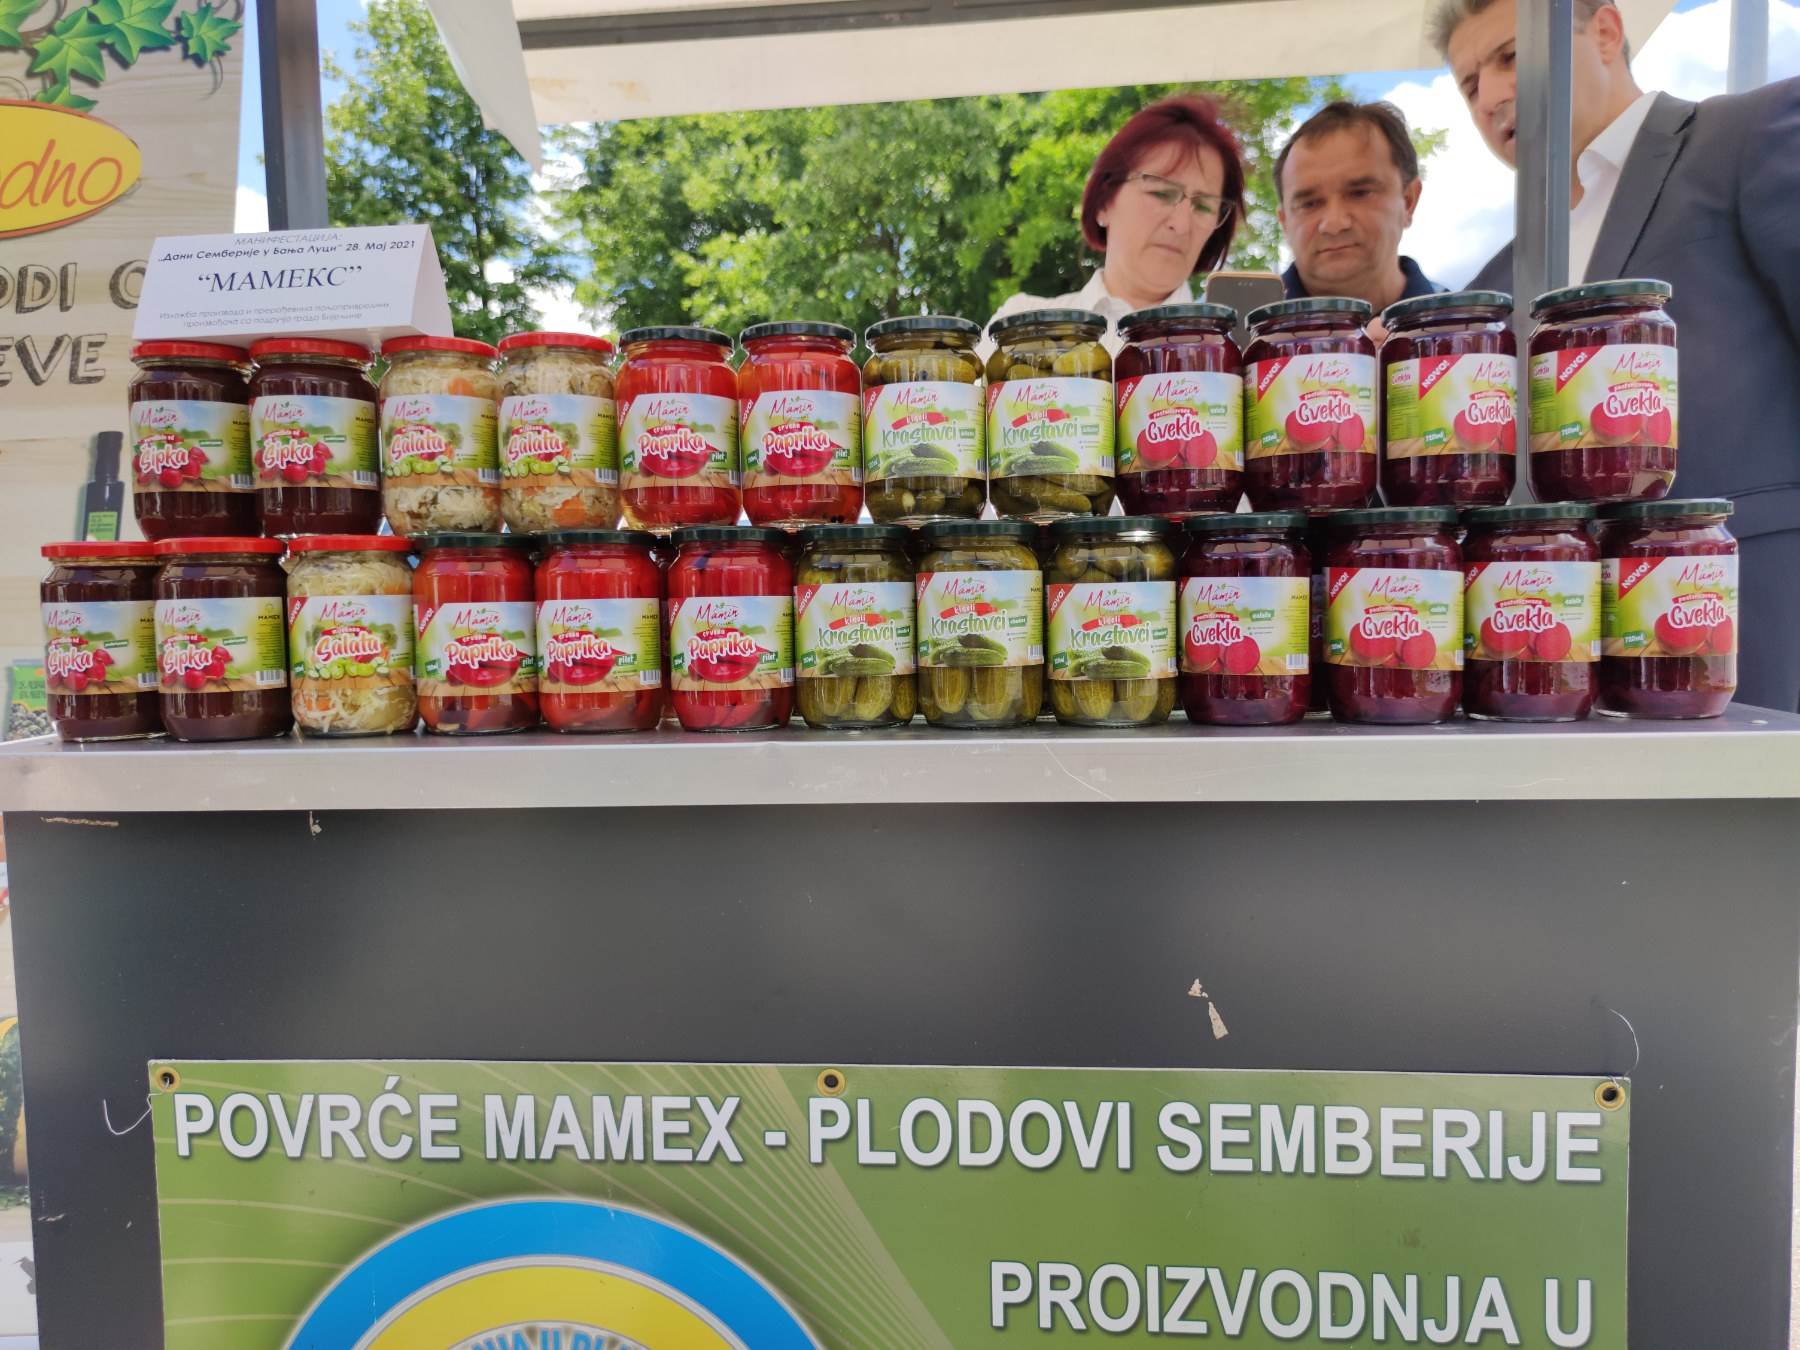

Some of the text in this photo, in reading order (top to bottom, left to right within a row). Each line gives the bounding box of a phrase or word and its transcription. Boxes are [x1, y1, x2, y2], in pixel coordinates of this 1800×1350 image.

[196, 248, 260, 260] Семберије
[273, 246, 304, 256] Бања
[389, 240, 416, 249] 2021
[1299, 399, 1352, 423] Cvekla
[1605, 391, 1662, 416] Cvekla
[1147, 415, 1201, 441] Cvekla
[391, 430, 446, 462] Salata
[508, 429, 562, 461] Salata
[638, 428, 706, 459] Paprika
[762, 426, 830, 458] Paprika
[931, 610, 1006, 636] Krastavci
[1362, 613, 1420, 637] Cvekla
[1493, 606, 1554, 631] Cvekla
[1671, 600, 1725, 626] Cvekla
[818, 620, 894, 647] Krastavci
[1070, 622, 1151, 648] Krastavci
[1191, 620, 1241, 644] Cvekla
[316, 631, 381, 662] Salata
[444, 637, 516, 668] Paprika
[546, 634, 611, 666] Paprika
[687, 631, 755, 664] Paprika
[173, 1075, 1602, 1183] POVRĆE MAMEX - PLODOVI SEMBERIJE
[989, 1260, 1593, 1349] PROIZVODNJA U
